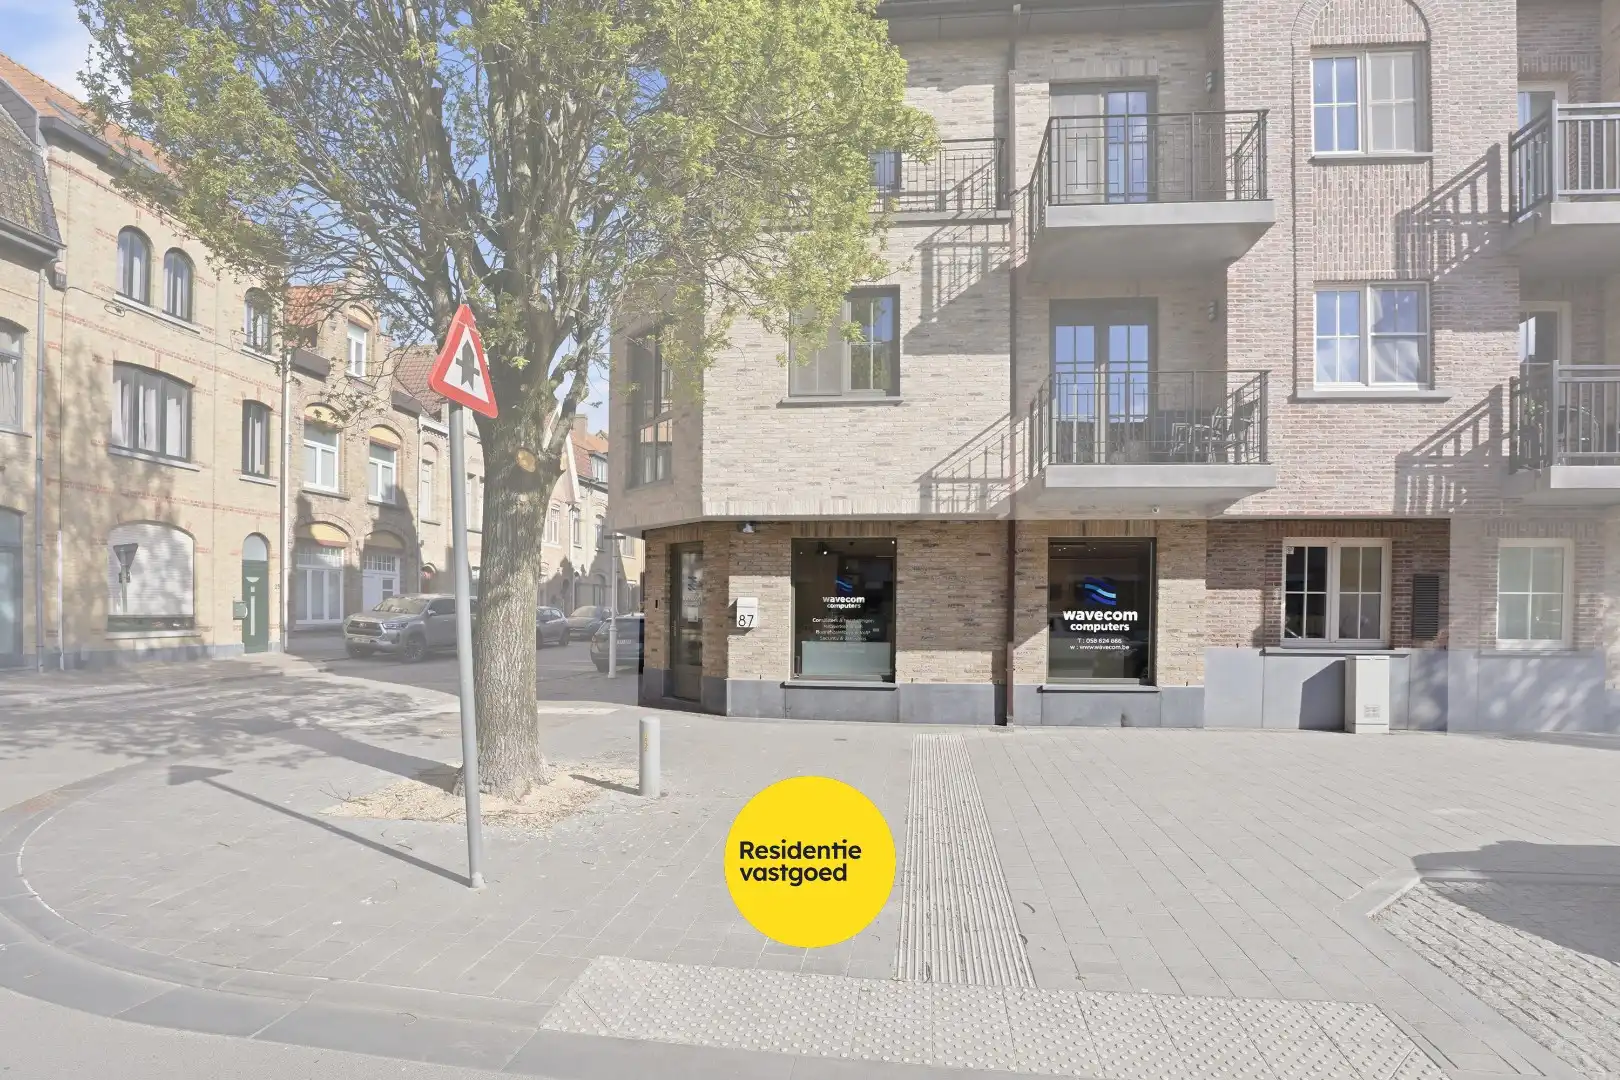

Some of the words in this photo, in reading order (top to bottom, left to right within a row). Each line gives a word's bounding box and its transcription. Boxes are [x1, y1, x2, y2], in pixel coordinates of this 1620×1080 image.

[738, 614, 754, 627] 87
[1062, 610, 1138, 621] wavecom
[1070, 622, 1130, 633] computers
